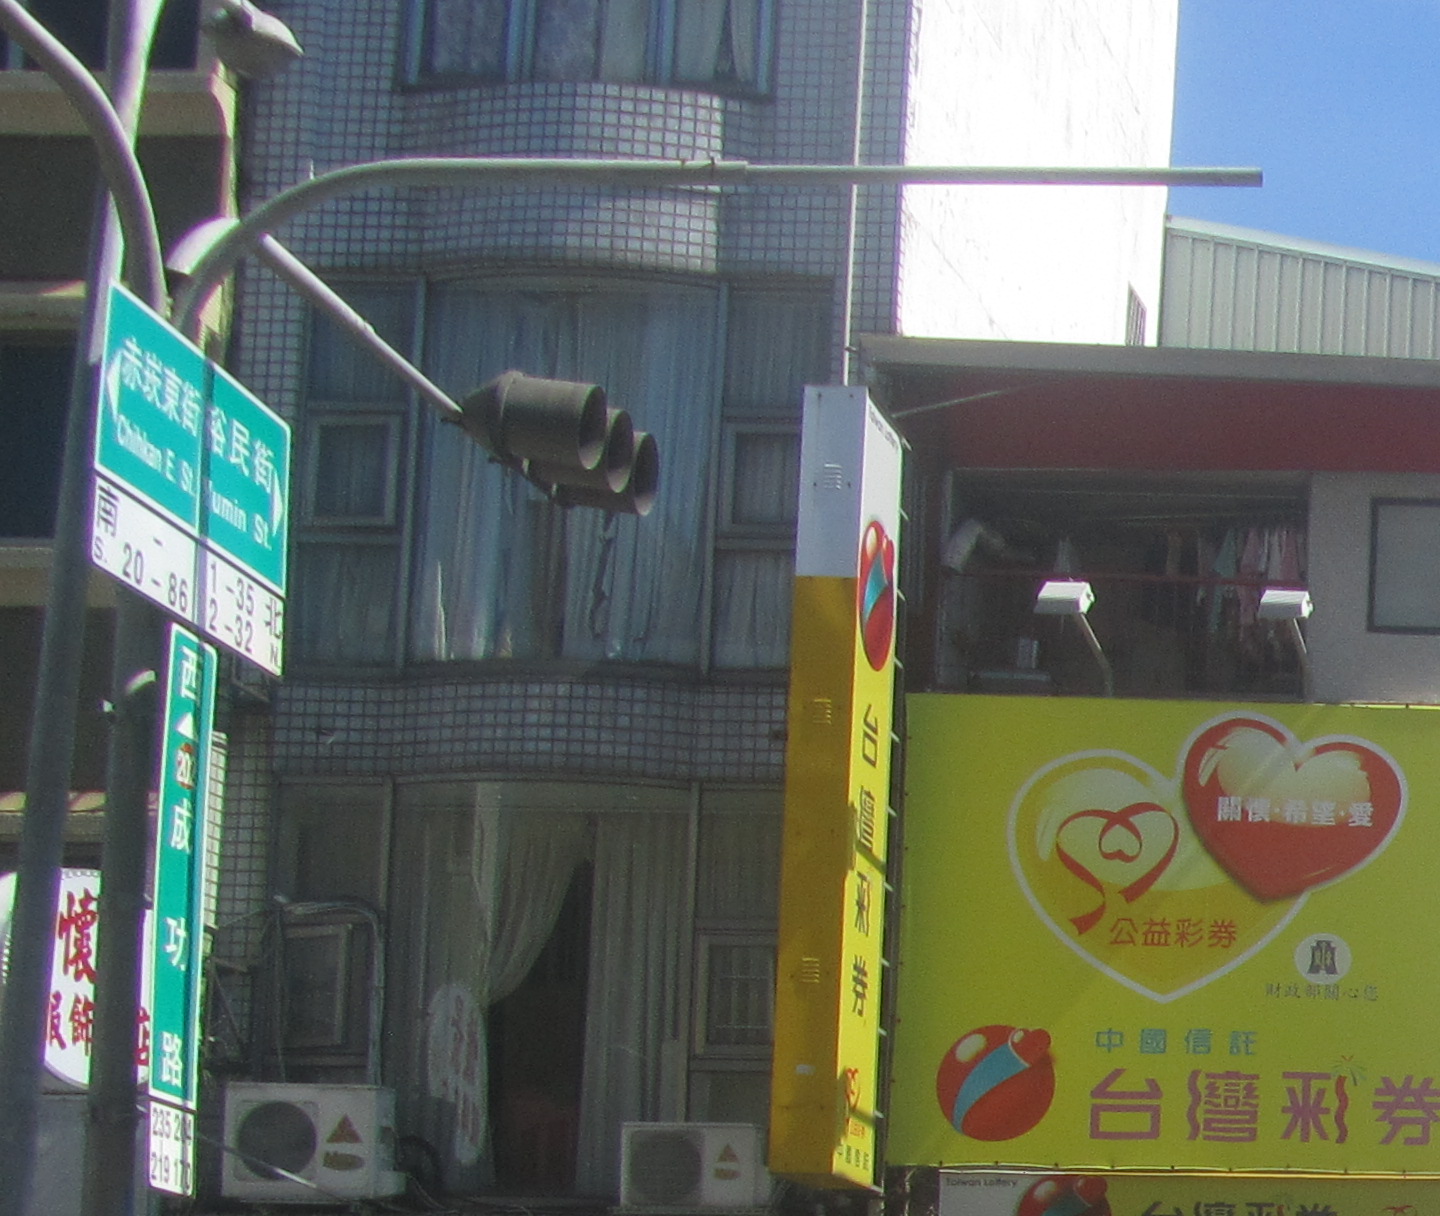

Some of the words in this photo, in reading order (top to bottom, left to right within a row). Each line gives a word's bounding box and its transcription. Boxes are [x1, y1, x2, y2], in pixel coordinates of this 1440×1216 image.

[96, 485, 120, 538] 南
[208, 479, 248, 534] umin
[121, 541, 189, 615] 20-86
[209, 561, 256, 617] 1-35
[208, 597, 254, 655] 2-32
[264, 596, 284, 641] 北
[161, 797, 194, 1090] 成功路
[1108, 916, 1239, 950] 公益彩券
[1094, 1027, 1259, 1057] 中國信託
